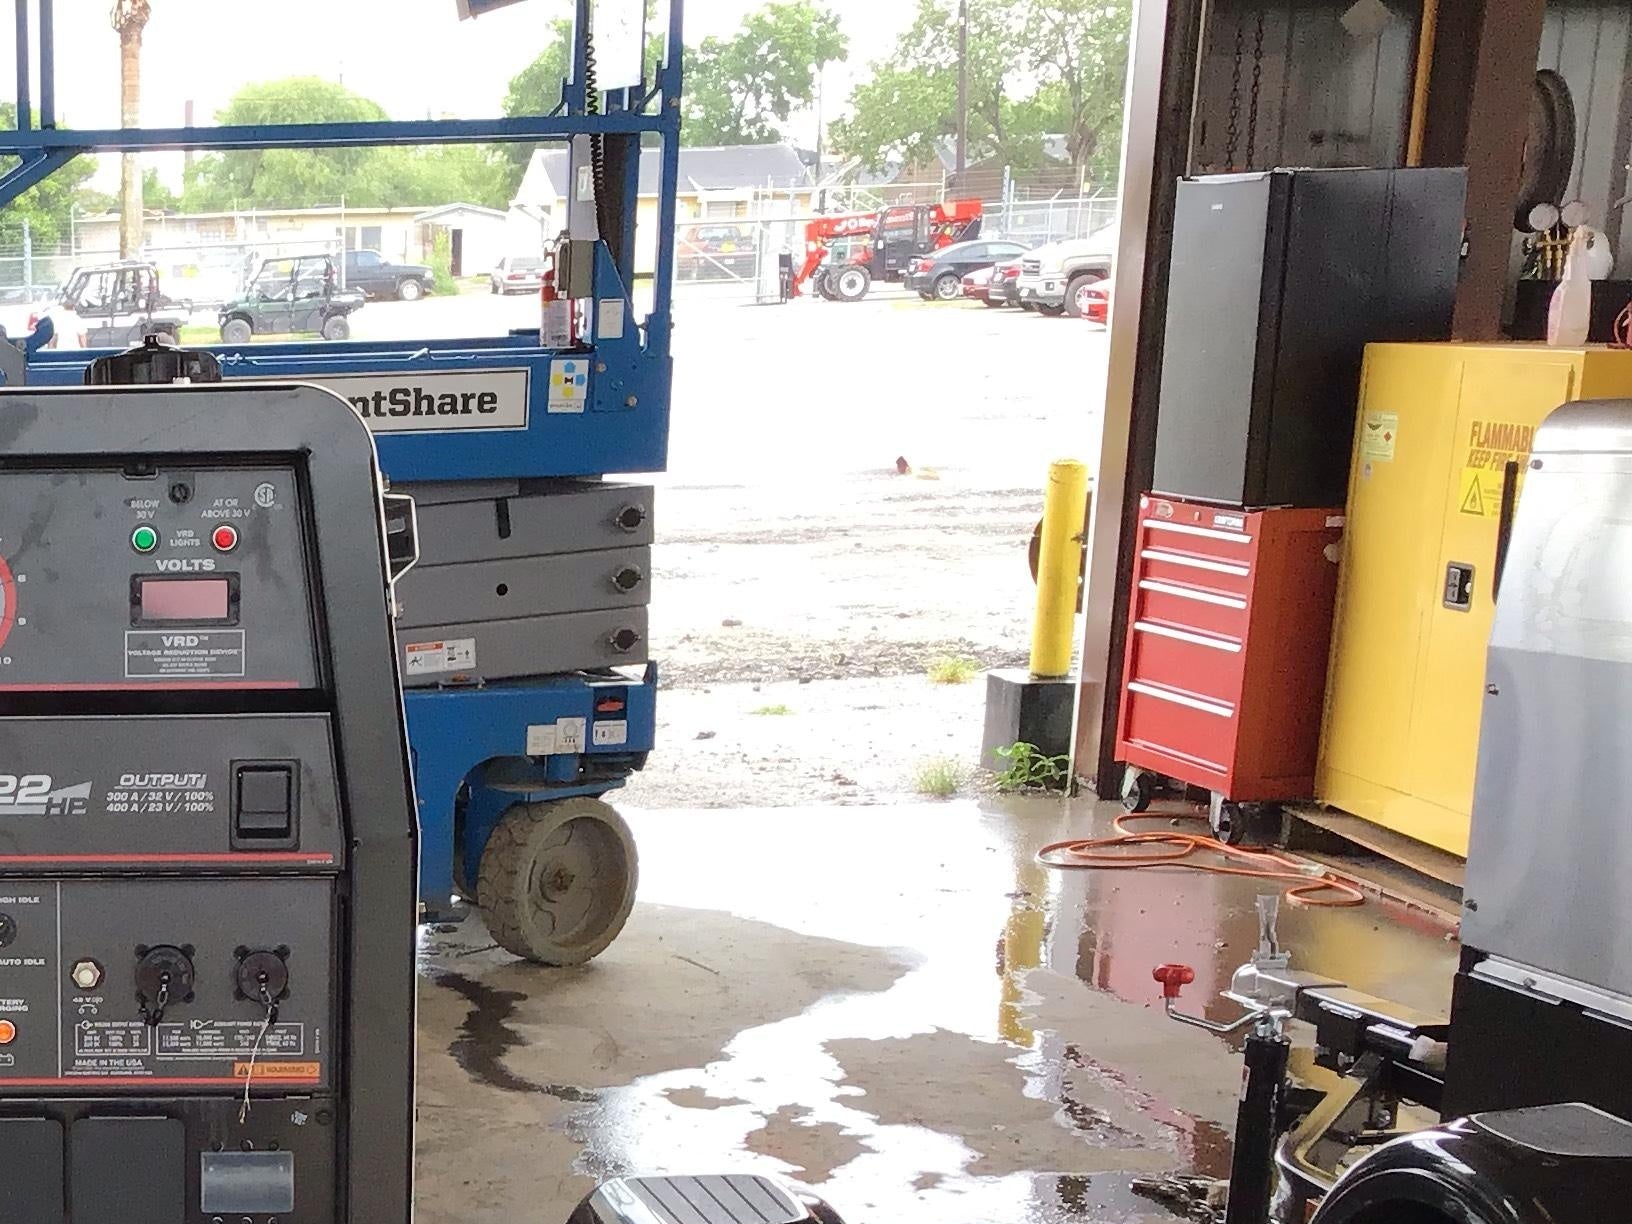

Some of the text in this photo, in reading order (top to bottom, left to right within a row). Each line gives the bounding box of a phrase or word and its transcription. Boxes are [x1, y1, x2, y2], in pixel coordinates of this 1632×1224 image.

[348, 387, 498, 418] ntShare
[131, 500, 160, 508] BELOW
[201, 510, 231, 518] ABOVE
[170, 538, 200, 547] LIGHTS
[156, 559, 216, 571] VOLTS
[120, 774, 201, 786] OUTPUT
[106, 791, 129, 801] 300
[184, 791, 214, 801] 100%
[106, 802, 129, 812] 400
[184, 802, 214, 812] 100%
